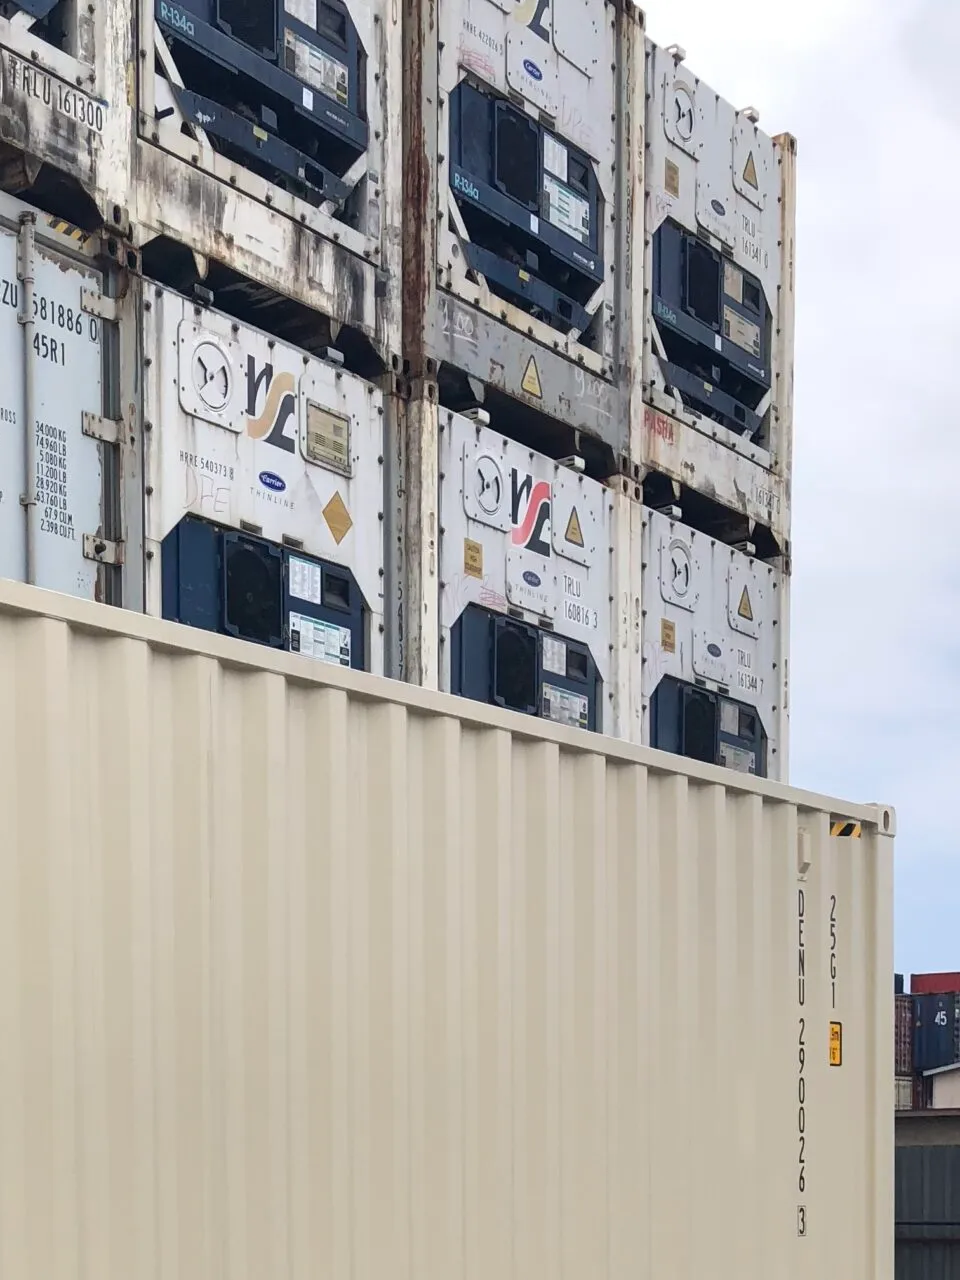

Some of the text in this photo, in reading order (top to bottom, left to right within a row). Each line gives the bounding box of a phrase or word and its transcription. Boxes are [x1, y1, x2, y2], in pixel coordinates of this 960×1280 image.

[160, 2, 195, 37] R-134a
[57, 84, 103, 132] 161300
[454, 172, 479, 201] R-134a
[742, 214, 756, 239] TRLU
[90, 318, 97, 342] 0
[33, 332, 65, 367] 45R1
[58, 428, 67, 443] KG
[58, 442, 67, 457] LB
[58, 456, 67, 470] KG
[179, 450, 198, 467] HRRE
[200, 457, 227, 477] 540373
[58, 469, 67, 484] LB
[260, 473, 284, 489] Carrier
[59, 483, 67, 497] KG
[249, 486, 295, 510] THINLINE
[59, 497, 67, 511] LB
[563, 575, 581, 598] TRLU
[564, 600, 598, 628] 160816 3
[934, 1010, 948, 1026] 45
[798, 1207, 805, 1235] 3
